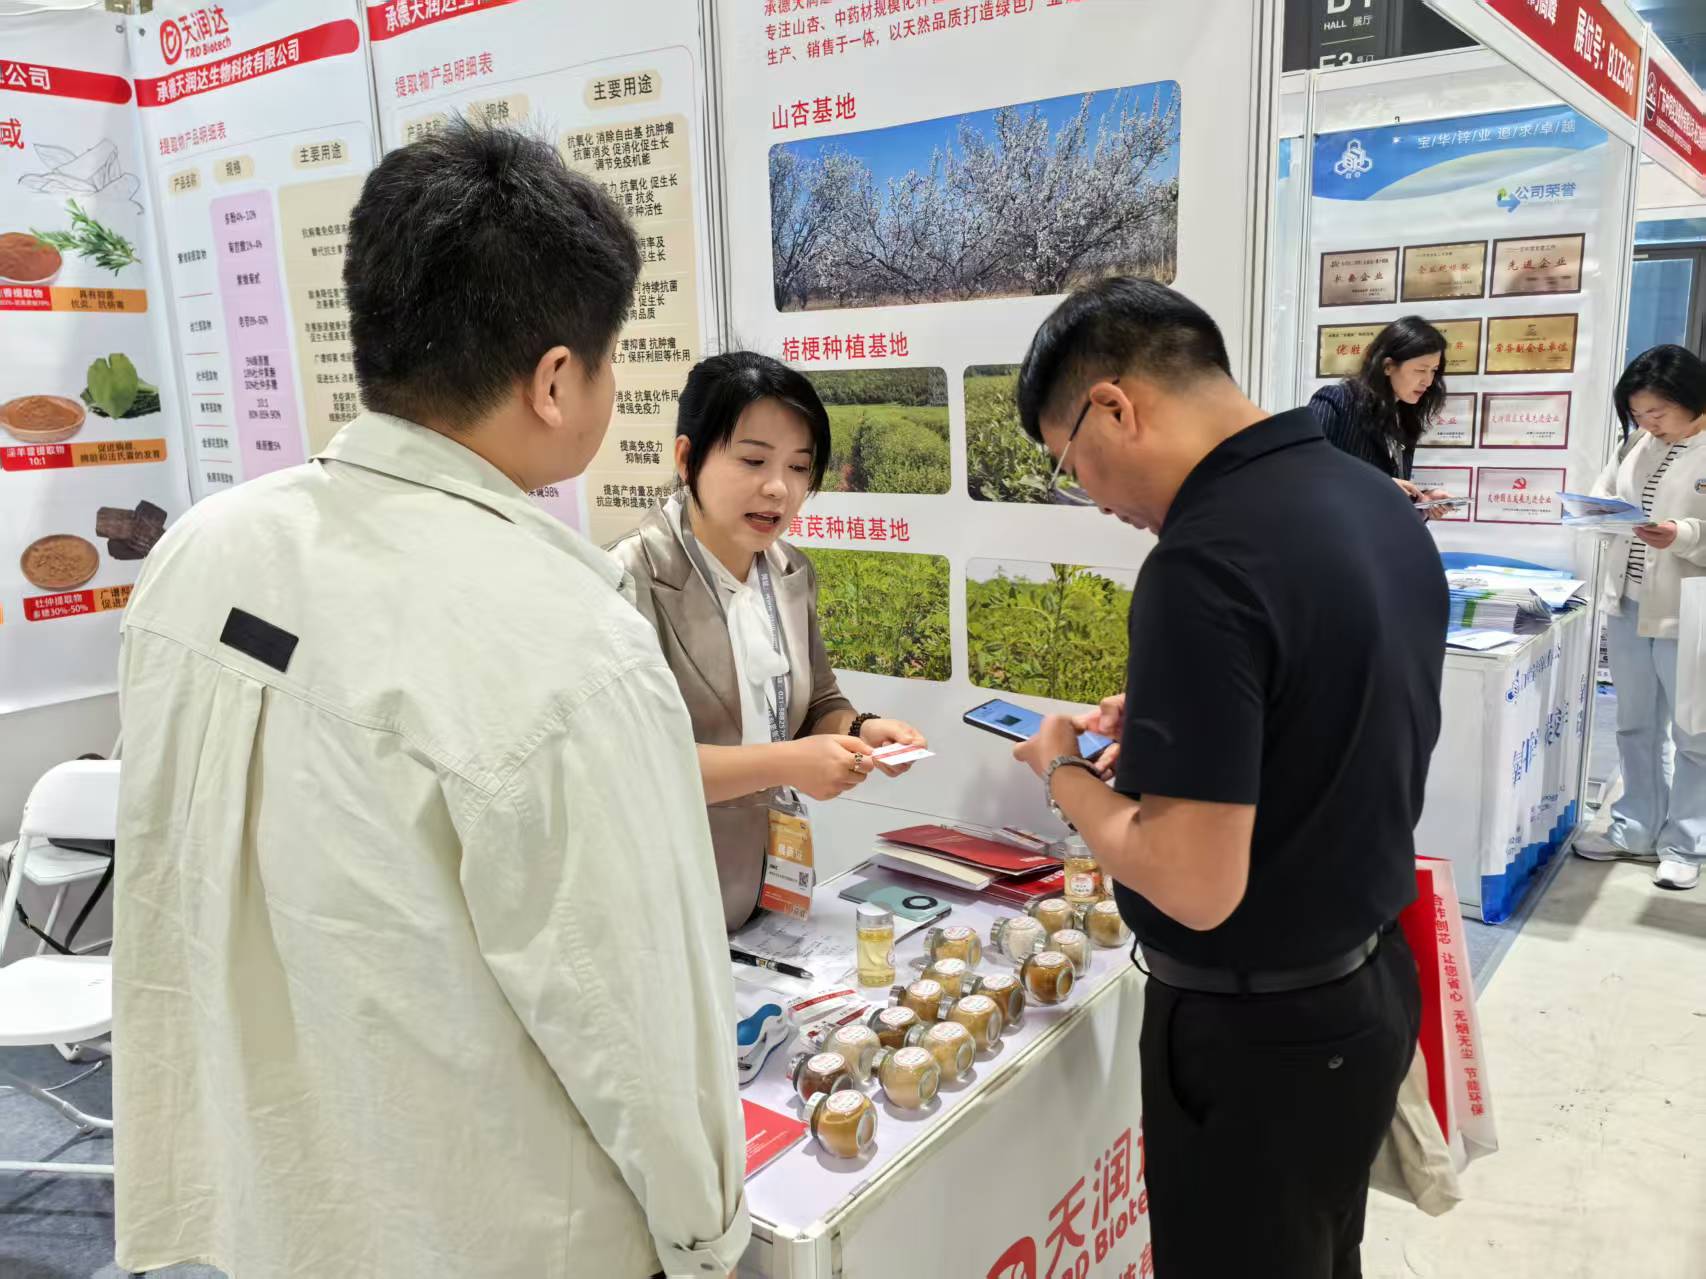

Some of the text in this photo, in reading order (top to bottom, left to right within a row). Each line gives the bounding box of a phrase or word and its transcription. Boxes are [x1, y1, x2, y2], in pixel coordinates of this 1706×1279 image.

[178, 5, 229, 45] 天润达
[385, 0, 483, 32] 承德天润
[1323, 20, 1347, 30] HALL
[0, 64, 51, 90] 公司
[157, 38, 300, 103] 承德天润达生物科技有限公司
[395, 52, 494, 97] 提取物产品明细表
[593, 74, 652, 101] 主要用途
[772, 92, 856, 129] 山杏基地
[596, 126, 643, 144] 消除自由基
[299, 142, 342, 163] 主要用途
[573, 136, 669, 161] 抗菌消炎 促消化促生长
[594, 153, 651, 171] 调节免疫机能
[619, 178, 647, 193] 抗氧化
[650, 173, 678, 189] 促生长
[1514, 182, 1577, 200] 公司荣誉
[628, 349, 691, 364] 保肝利胆等作用
[782, 331, 910, 361] 桔梗种植基地
[634, 389, 679, 402] 抗氧化作用
[616, 402, 661, 415] 增强免疫力
[620, 440, 663, 453] 提高免疫力
[29, 457, 46, 466] 10:1
[625, 453, 661, 465] 抑制病毒
[787, 514, 910, 542] 黄芪种植基地
[1464, 1067, 1485, 1117] 节能环保
